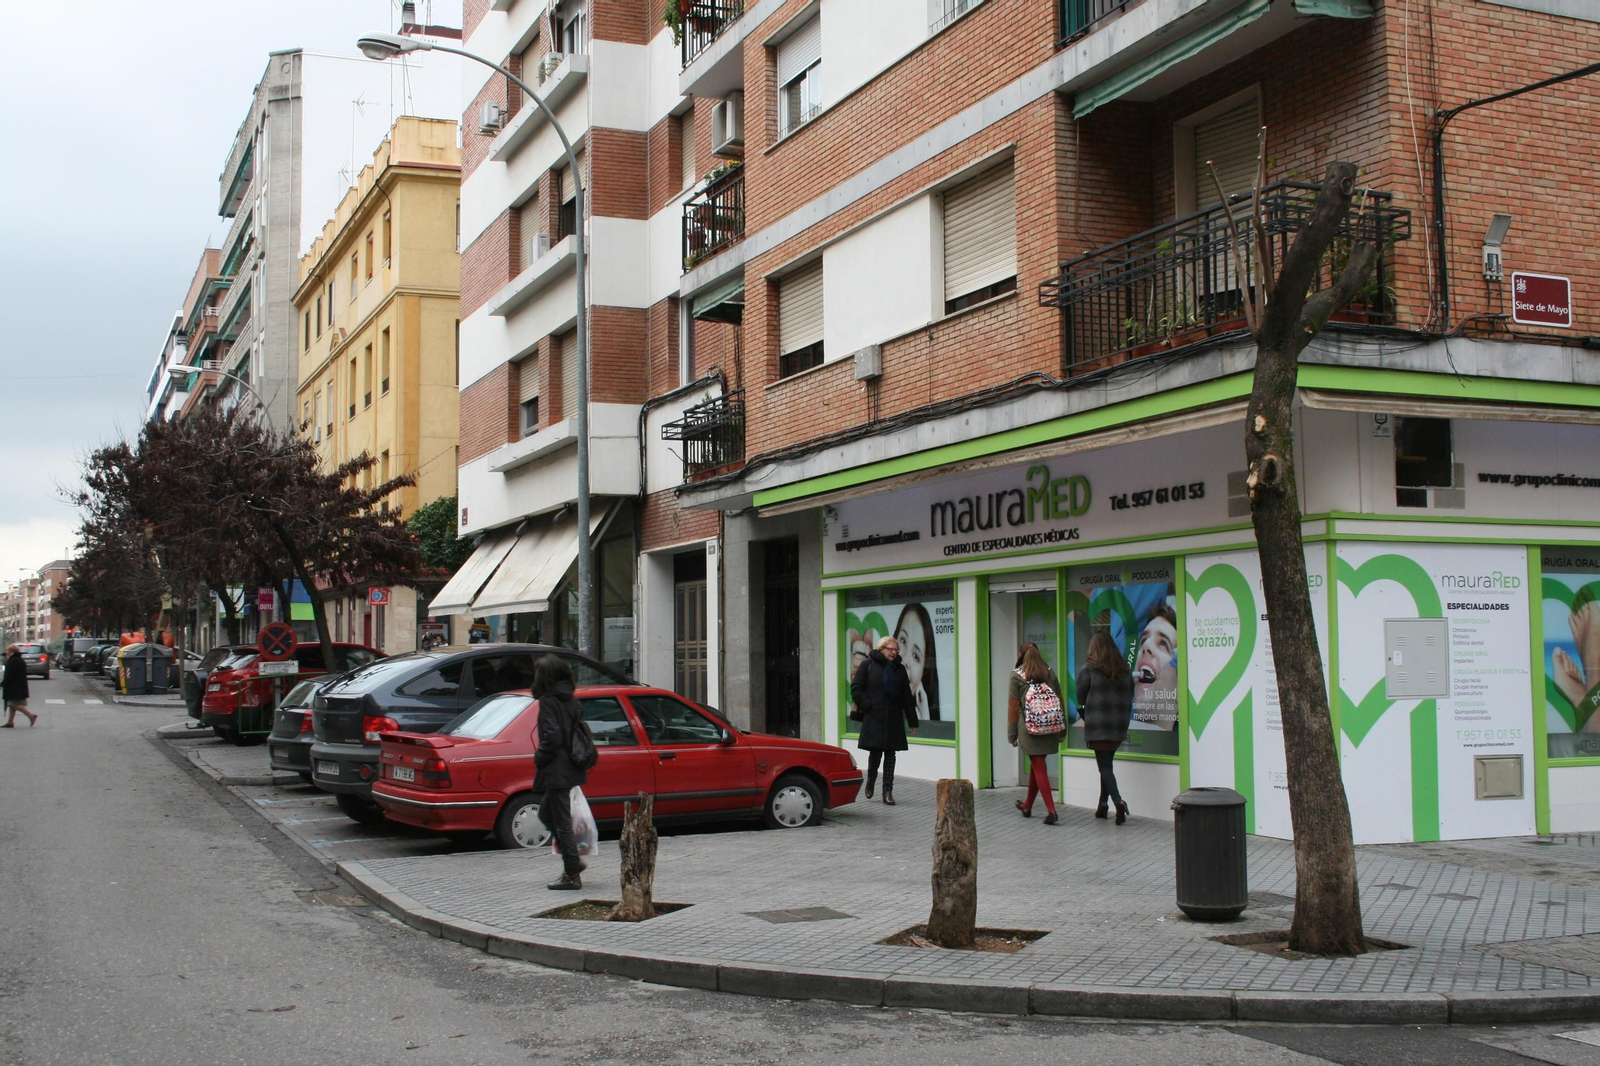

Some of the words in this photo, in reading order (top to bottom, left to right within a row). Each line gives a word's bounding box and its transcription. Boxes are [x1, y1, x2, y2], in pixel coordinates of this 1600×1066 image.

[1516, 301, 1534, 311] Siete
[1536, 303, 1546, 312] de
[1548, 304, 1568, 316] Mayo
[931, 464, 1092, 537] mauraMED
[1131, 490, 1154, 508] 957
[1156, 488, 1168, 504] 61
[1171, 485, 1186, 502] 01
[1188, 482, 1205, 499] 53
[944, 542, 970, 556] CENTRO
[972, 540, 981, 552] DE
[982, 533, 1042, 551] ESPECIALIDADES
[1044, 528, 1080, 542] MÉDICAS
[1575, 559, 1600, 568] ORAL
[1080, 574, 1103, 584] CIRUGÍA
[1105, 574, 1121, 582] ORAL
[1132, 568, 1170, 580] PODOLOGÍA
[1442, 571, 1520, 588] mauraMED
[1195, 618, 1202, 626] te
[1204, 615, 1239, 626] cuidamos
[1197, 626, 1206, 636] de
[1207, 626, 1224, 636] todo
[1192, 632, 1234, 648] corazón
[1143, 688, 1153, 699] Tu
[1156, 688, 1177, 700] salud
[1132, 702, 1156, 711] siempre
[1166, 702, 1174, 710] las
[1134, 712, 1158, 721] mejores
[1485, 730, 1493, 739] 61
[1497, 729, 1506, 739] 01
[1510, 729, 1521, 739] 53
